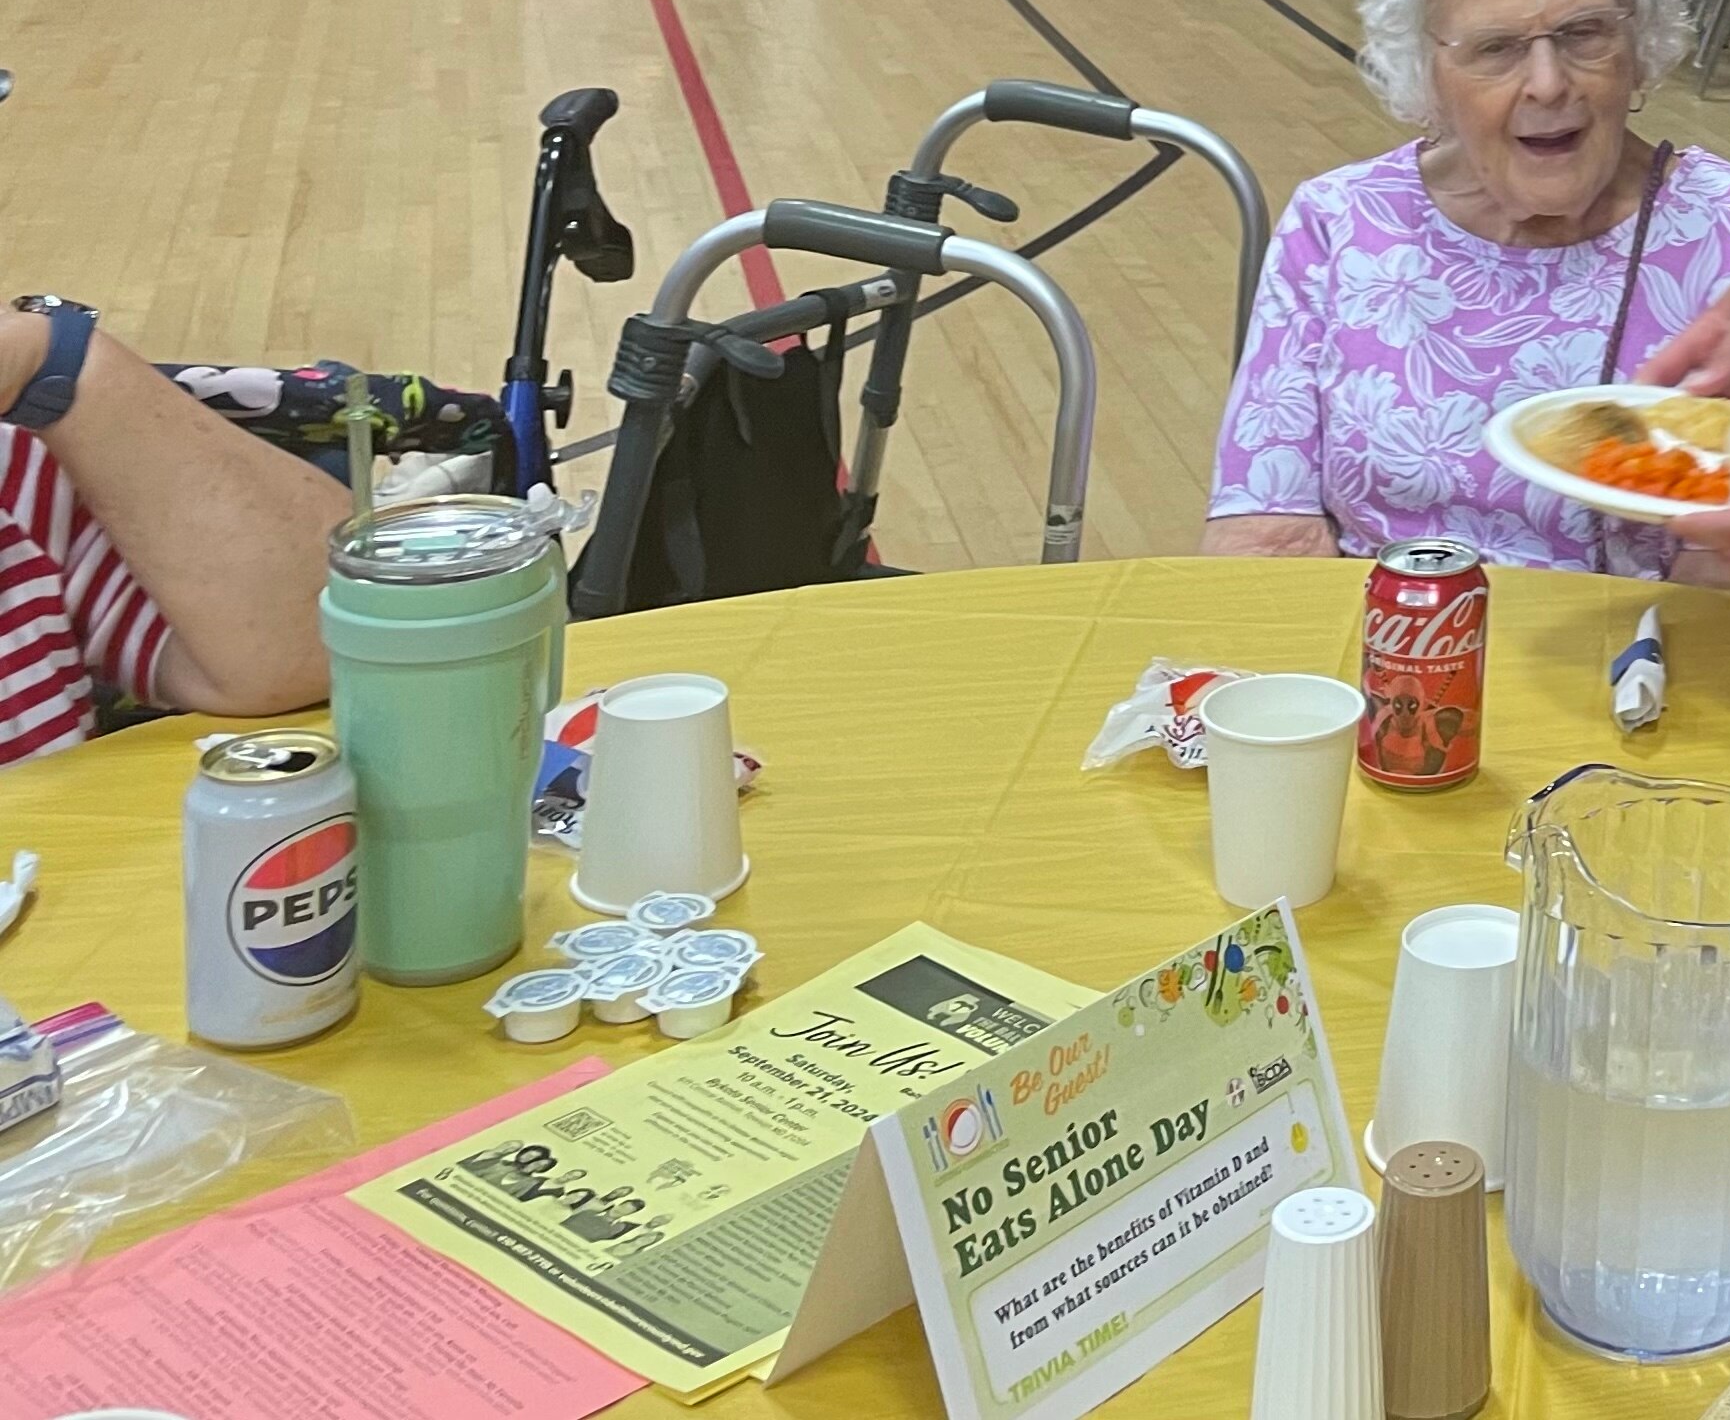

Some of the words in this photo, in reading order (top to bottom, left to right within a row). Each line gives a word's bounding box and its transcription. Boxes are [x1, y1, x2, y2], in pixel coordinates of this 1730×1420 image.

[1427, 661, 1465, 674] TASTE
[736, 1071, 756, 1083] 10
[770, 1010, 877, 1057] Join
[868, 1042, 966, 1079] Us!
[785, 1054, 856, 1094] Saturday,
[1011, 1069, 1043, 1106] Be
[1049, 1032, 1091, 1077] Our
[1044, 1043, 1111, 1116] Guest!
[728, 1045, 809, 1090] September
[804, 1086, 834, 1104] 21,
[830, 1099, 880, 1122] 2024
[739, 1095, 775, 1115] Senior
[772, 1113, 809, 1131] Center
[942, 1184, 994, 1235] No
[1002, 1108, 1118, 1197] Senior
[953, 1207, 1037, 1279] Eats
[1047, 1142, 1145, 1224] Alone
[1149, 1098, 1209, 1157] Day
[994, 1287, 1040, 1324] What
[1042, 1271, 1068, 1297] are
[1069, 1256, 1096, 1278] the
[1096, 1213, 1156, 1262] benefits
[1158, 1198, 1174, 1221] of
[1174, 1166, 1230, 1208] Vitamin
[1231, 1154, 1242, 1173] D
[1244, 1135, 1270, 1165] and
[1009, 1315, 1050, 1350] from
[1051, 1283, 1092, 1321] what
[1094, 1248, 1149, 1295] sources
[1151, 1231, 1177, 1256] can
[1178, 1220, 1192, 1239] it
[1192, 1209, 1210, 1230] be
[1007, 1349, 1078, 1404] TRIVIA
[1075, 1310, 1130, 1358] TIME!
